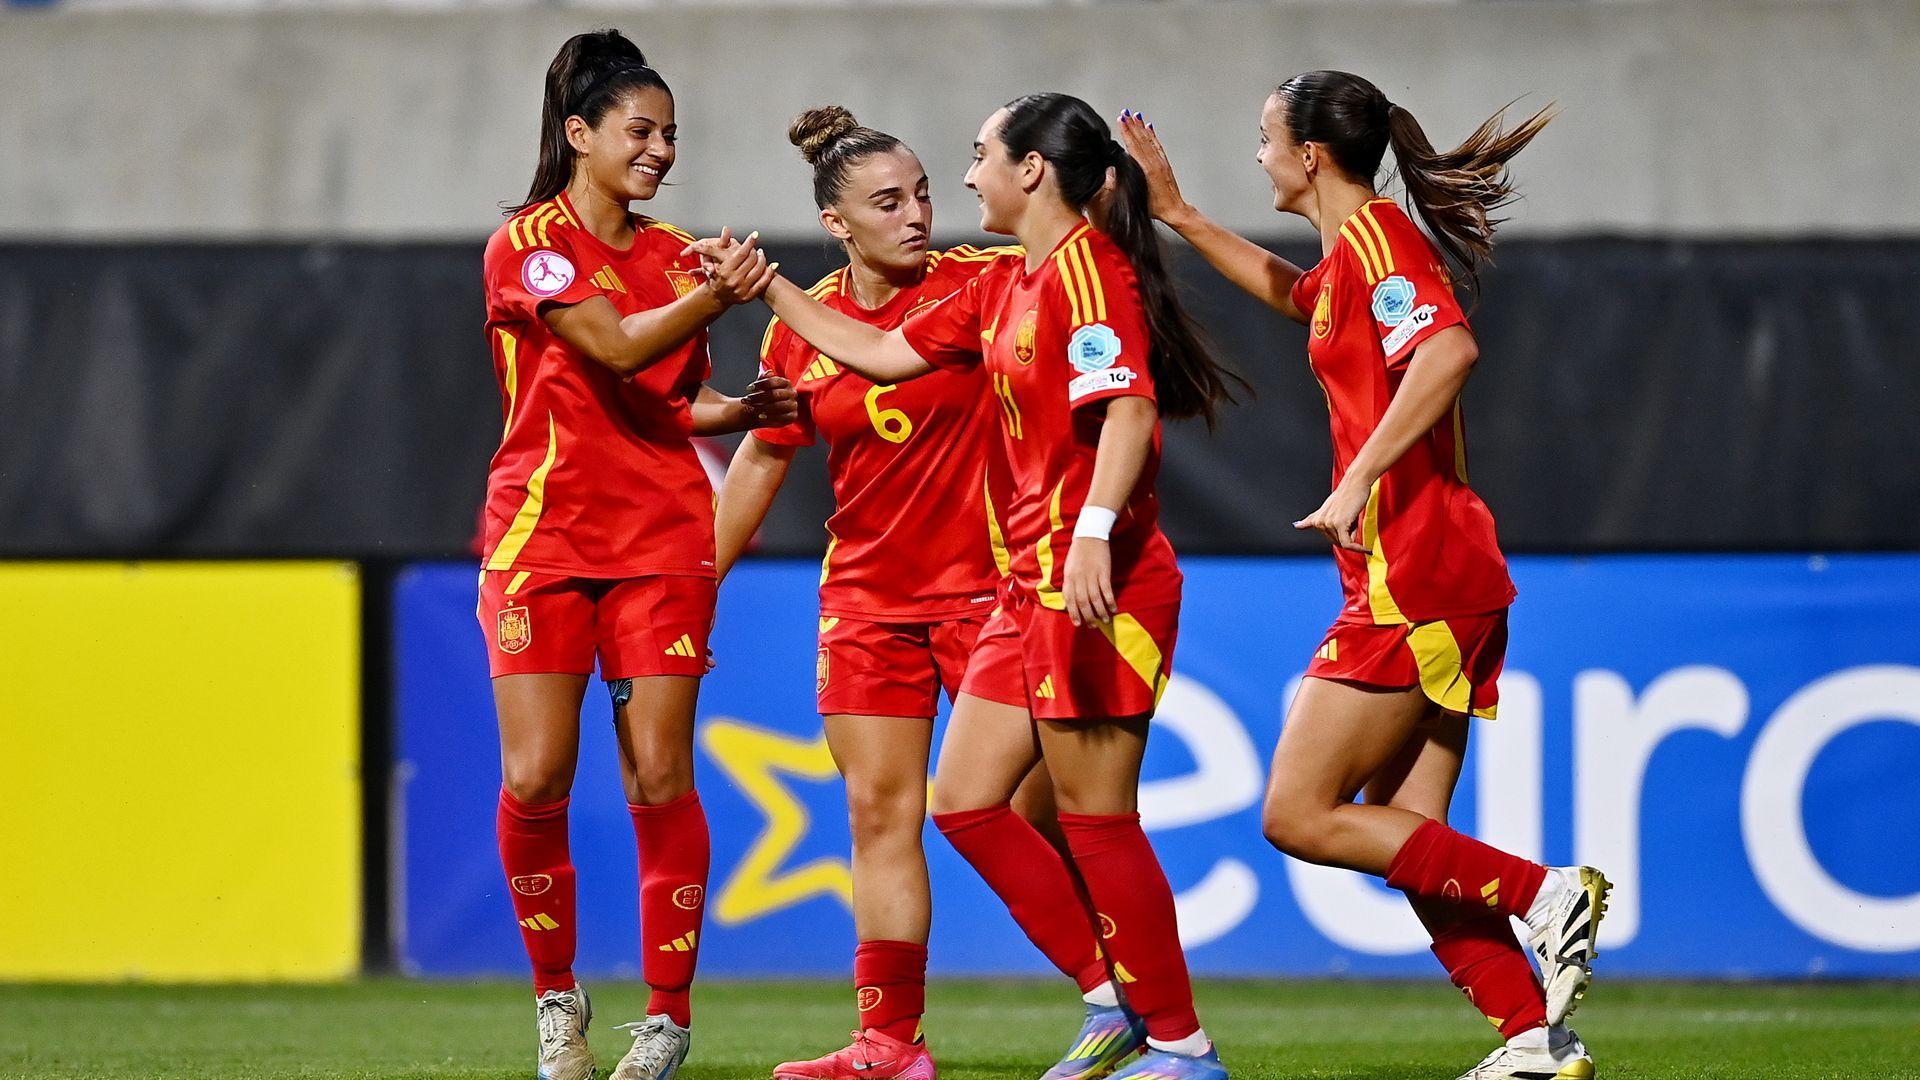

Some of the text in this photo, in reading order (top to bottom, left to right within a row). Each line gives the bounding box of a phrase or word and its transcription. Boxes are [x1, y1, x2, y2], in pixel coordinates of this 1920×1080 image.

[993, 371, 1023, 440] 11
[1109, 373, 1126, 382] 10
[864, 383, 913, 444] 6
